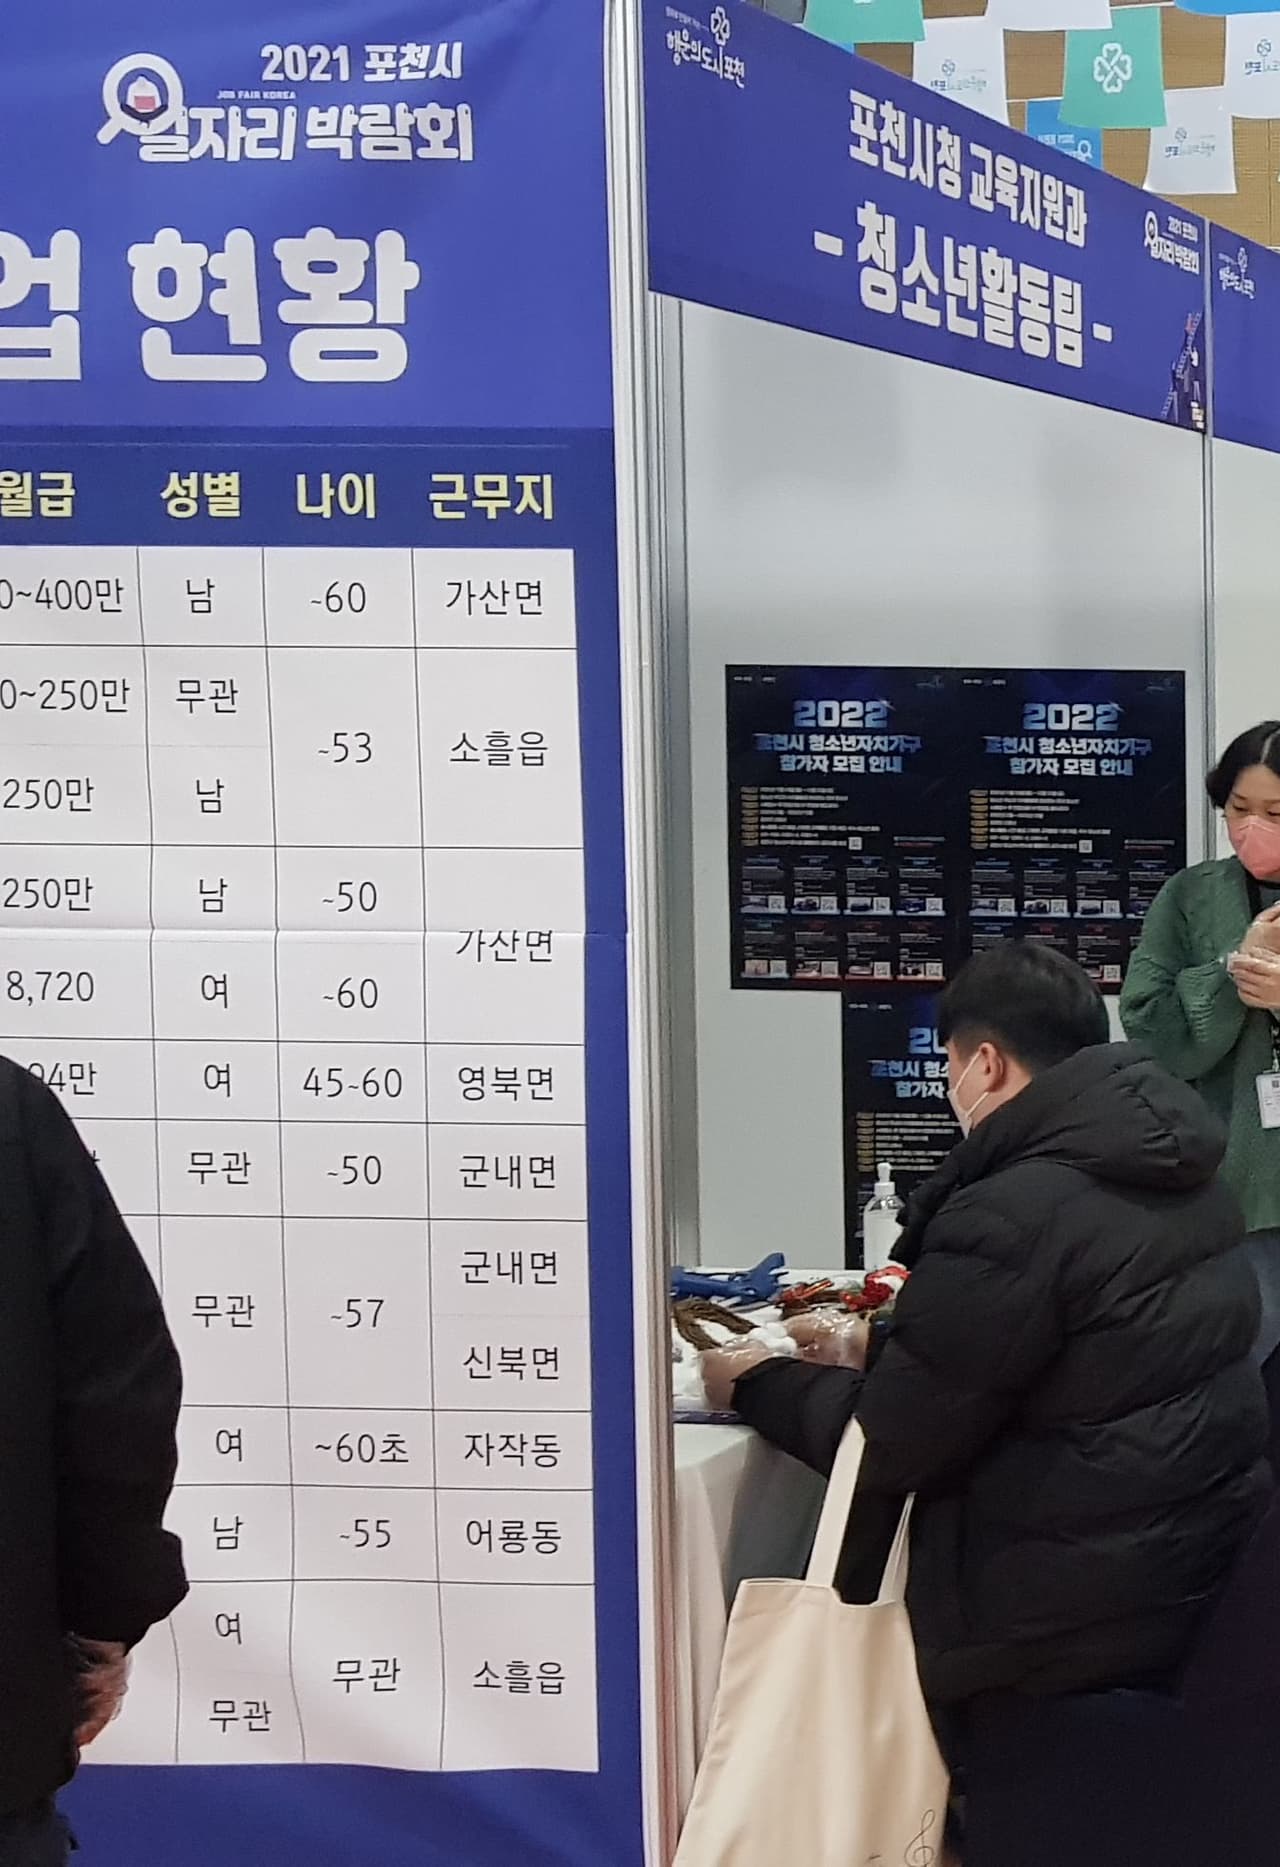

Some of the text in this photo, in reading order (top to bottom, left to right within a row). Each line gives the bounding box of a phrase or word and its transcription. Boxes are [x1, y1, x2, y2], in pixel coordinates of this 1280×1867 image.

[261, 42, 462, 81] 2021 포천시
[306, 103, 472, 160] 박람회
[848, 88, 1086, 248] 포천시청 교육지원과
[857, 201, 1083, 368] 청소년활동팀
[128, 228, 420, 382] 현황
[0, 471, 552, 519] 월급 성별 나이 근무지
[187, 579, 214, 613] 남
[312, 583, 367, 613] ~60
[446, 581, 543, 616] 가산면
[0, 678, 239, 713] 0~250만 무관
[794, 699, 890, 728] 2022
[1023, 702, 1120, 731] 2022
[318, 731, 547, 767] ~53 소흘읍
[780, 755, 903, 773] 참가자 모집 안내
[1010, 758, 1134, 776] 참가자 모집 안내
[3, 777, 224, 814] 250만 남
[3, 877, 377, 912] 250만 남 ~50
[457, 930, 554, 964] 가산면
[6, 971, 378, 1010] 8,720 여 ~60
[204, 1064, 231, 1098] 여
[303, 1068, 402, 1098] 45~60
[459, 1067, 555, 1101] 영북면
[188, 1152, 557, 1189] 무관 ~50 군내면
[462, 1252, 558, 1286] 군내면
[192, 1296, 384, 1329] 무관 ~57
[464, 1347, 560, 1380] 신북면
[215, 1428, 562, 1467] 여 ~60초 자작동
[213, 1516, 562, 1554] 남 ~55 어룡동
[216, 1612, 243, 1645] 여
[333, 1660, 566, 1694] 무관 소흘읍
[209, 1700, 271, 1733] 무관
